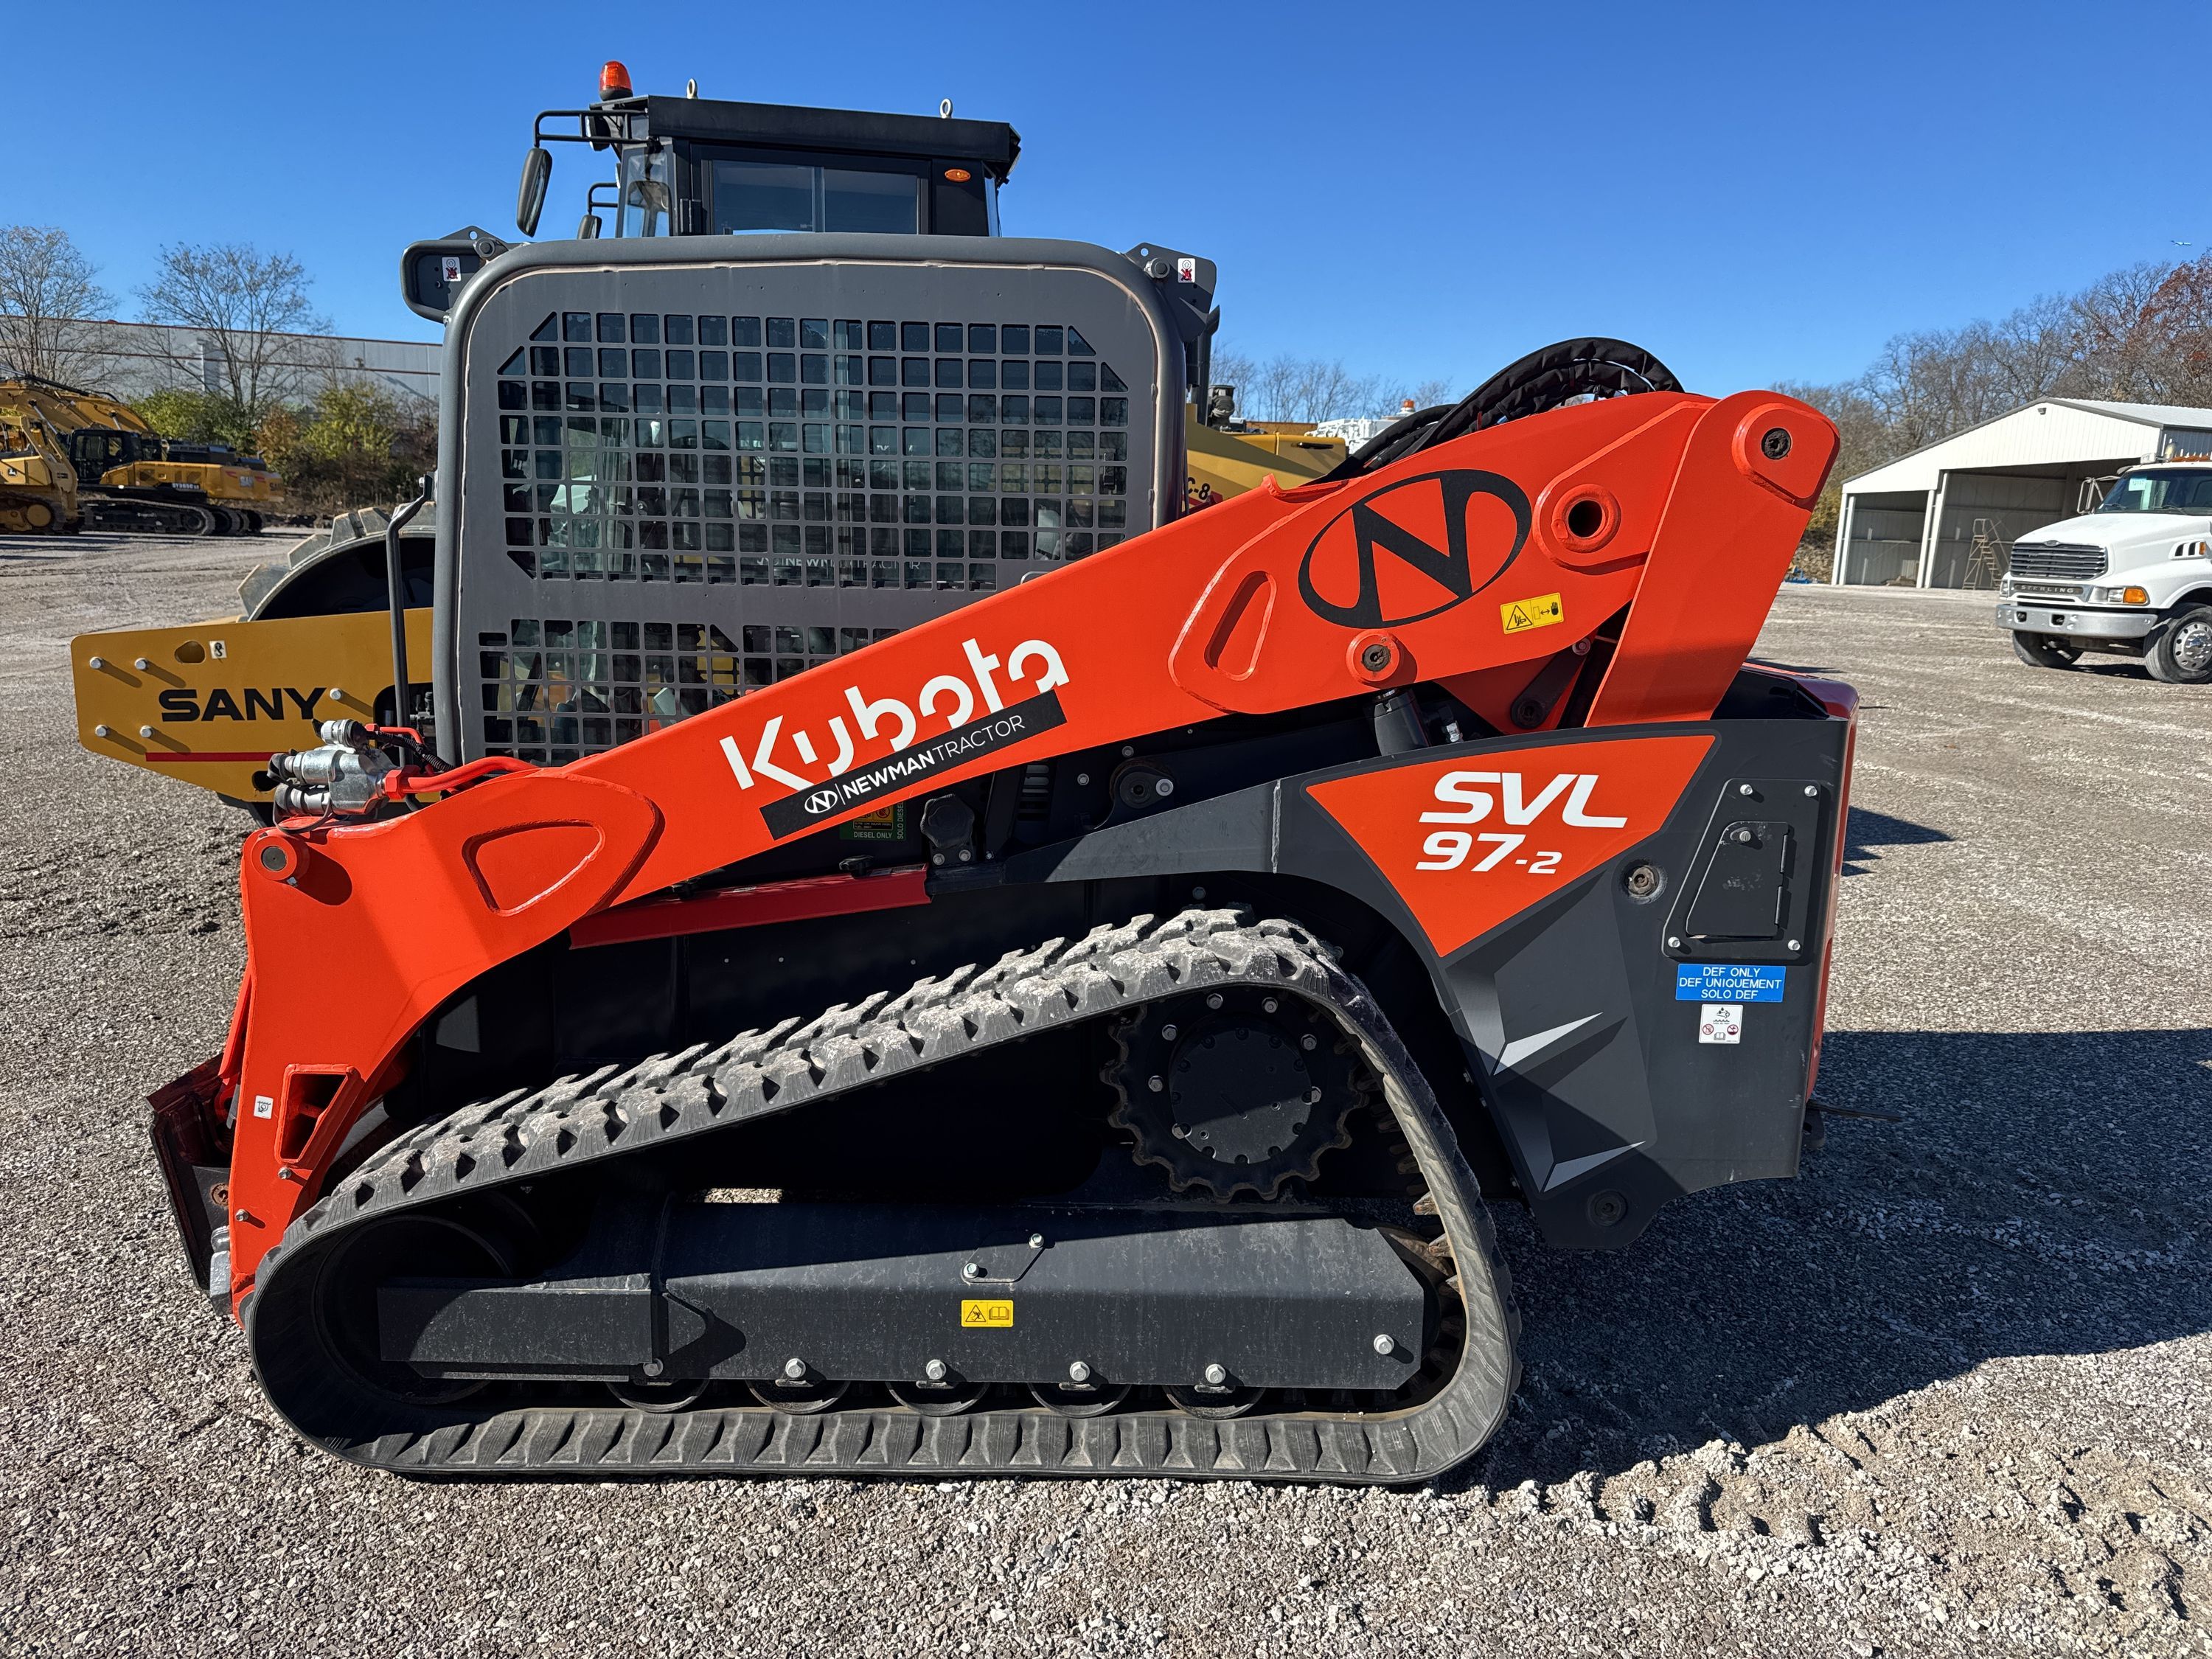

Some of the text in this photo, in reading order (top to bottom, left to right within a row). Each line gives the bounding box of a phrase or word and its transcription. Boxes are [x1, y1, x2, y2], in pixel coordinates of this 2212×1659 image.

[2021, 585, 2073, 593] STERLING
[159, 687, 327, 722] SANY
[719, 638, 1070, 791] Kubota
[843, 750, 935, 799] NEWMAN
[932, 714, 1026, 761] TRACTOR
[1419, 771, 1628, 828] SVL
[1415, 831, 1562, 874] 97-2
[1679, 977, 1782, 989] DEF UNIQUEMENT
[1703, 967, 1761, 978] DEF ONLY
[1700, 989, 1759, 1000] SOLO DEF
